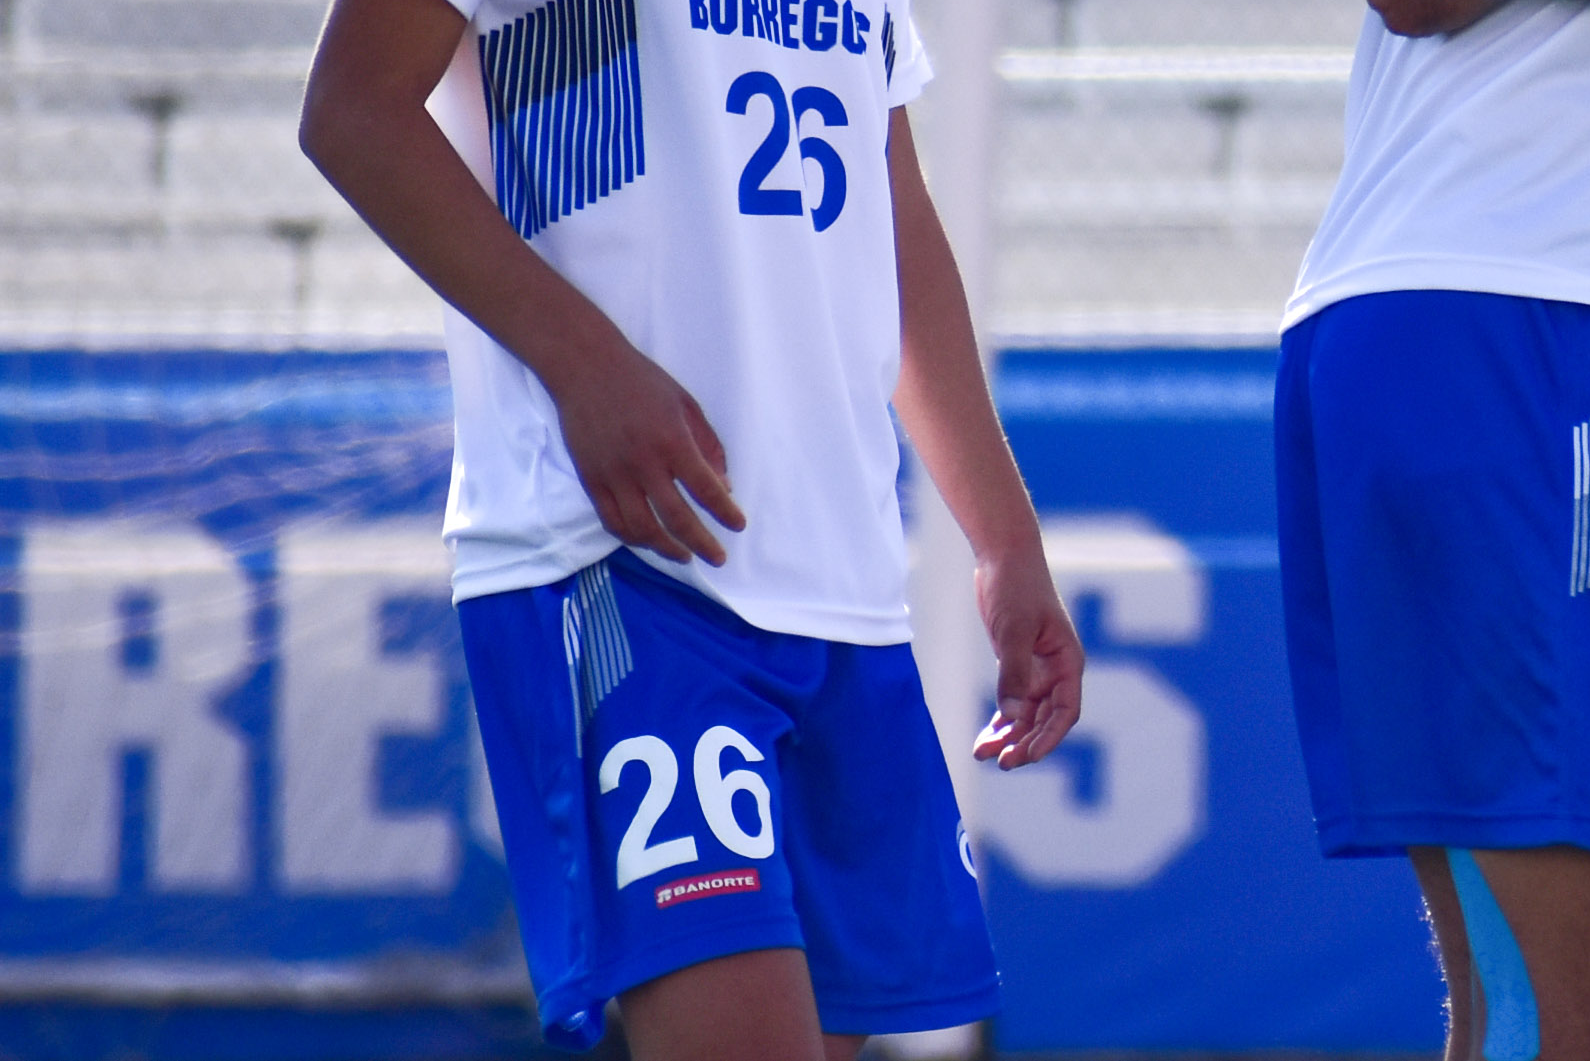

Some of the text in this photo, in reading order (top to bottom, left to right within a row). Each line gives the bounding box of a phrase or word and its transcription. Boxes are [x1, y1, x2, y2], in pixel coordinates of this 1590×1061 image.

[725, 70, 848, 233] 26
[599, 725, 774, 890] 26
[673, 876, 755, 896] BANORTE
